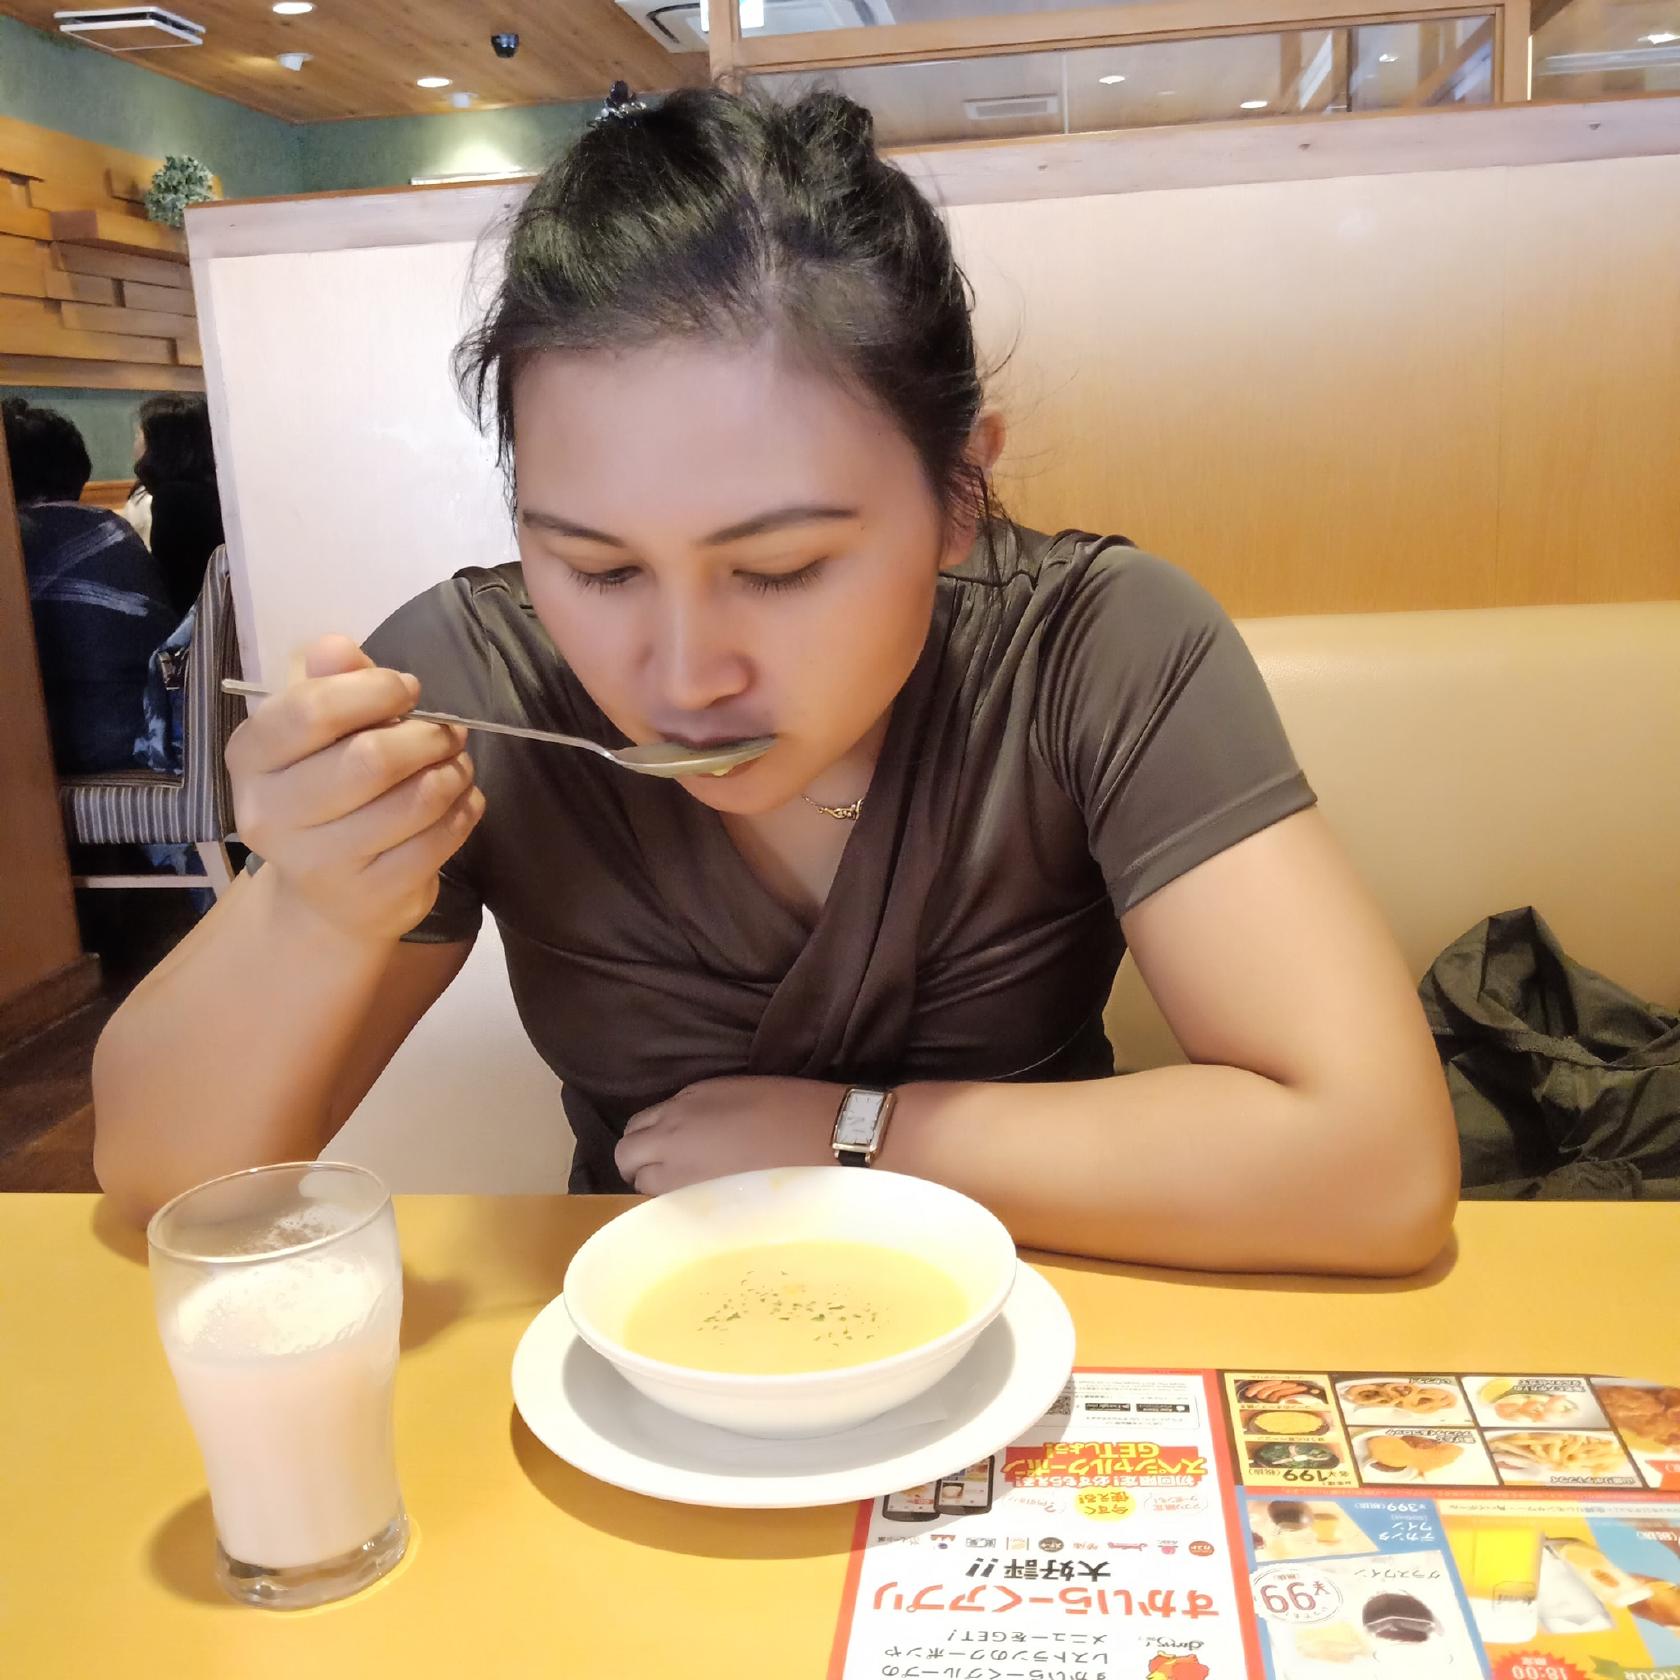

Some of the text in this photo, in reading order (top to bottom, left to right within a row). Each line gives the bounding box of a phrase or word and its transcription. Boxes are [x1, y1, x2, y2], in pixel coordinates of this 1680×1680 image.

[1044, 1442, 1160, 1459] GETしよう!
[1001, 1457, 1207, 1476] スペシャルクーポン
[1078, 1491, 1129, 1503] 使える!
[1085, 1504, 1128, 1515] 今すぐ
[1391, 1522, 1432, 1531] ワイン
[1378, 1531, 1435, 1542] デカンタ
[965, 1558, 1111, 1582] 大好評!!
[1354, 1569, 1441, 1580] グラスワイン
[873, 1581, 1219, 1619] すかいらーくアプリ
[1260, 1581, 1332, 1613] ¥99
[947, 1629, 1108, 1645] メニューをGET!
[884, 1646, 1108, 1665] レストランのクーポンや
